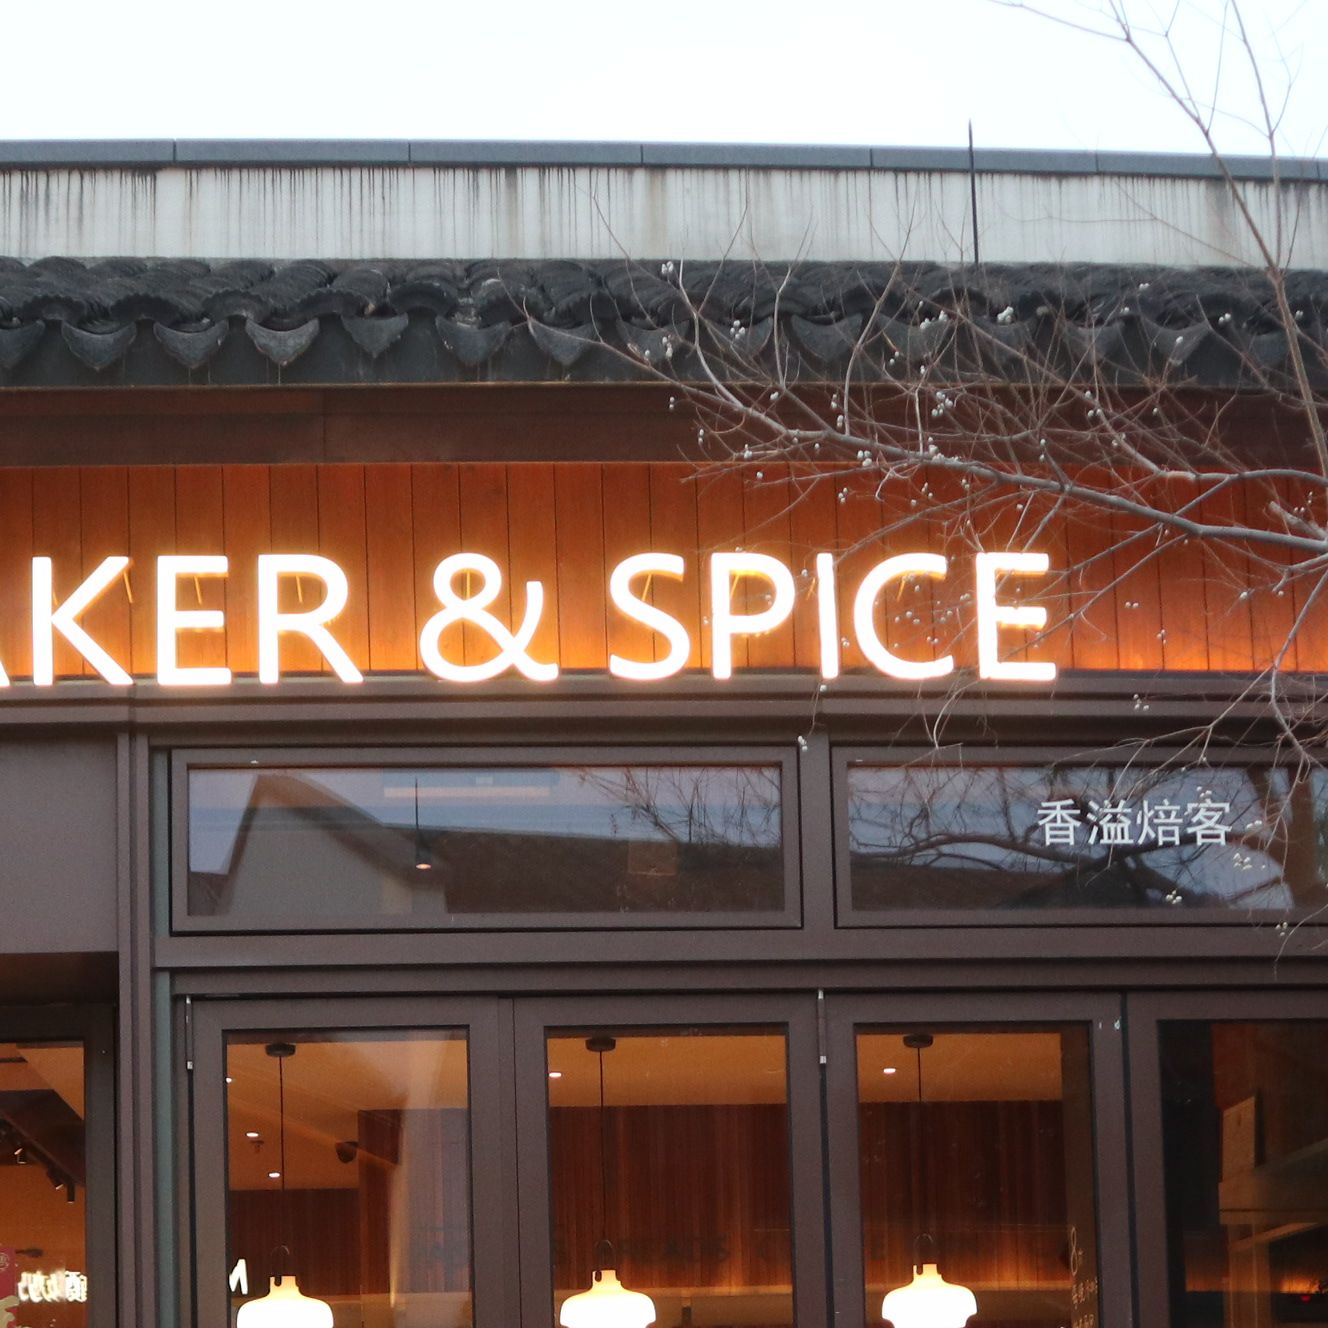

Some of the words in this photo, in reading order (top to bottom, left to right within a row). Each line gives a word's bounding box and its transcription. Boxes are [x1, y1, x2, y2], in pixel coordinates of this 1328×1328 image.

[418, 552, 561, 683] &
[608, 551, 1058, 682] SPICE
[1036, 798, 1233, 847] 香溢焙客
